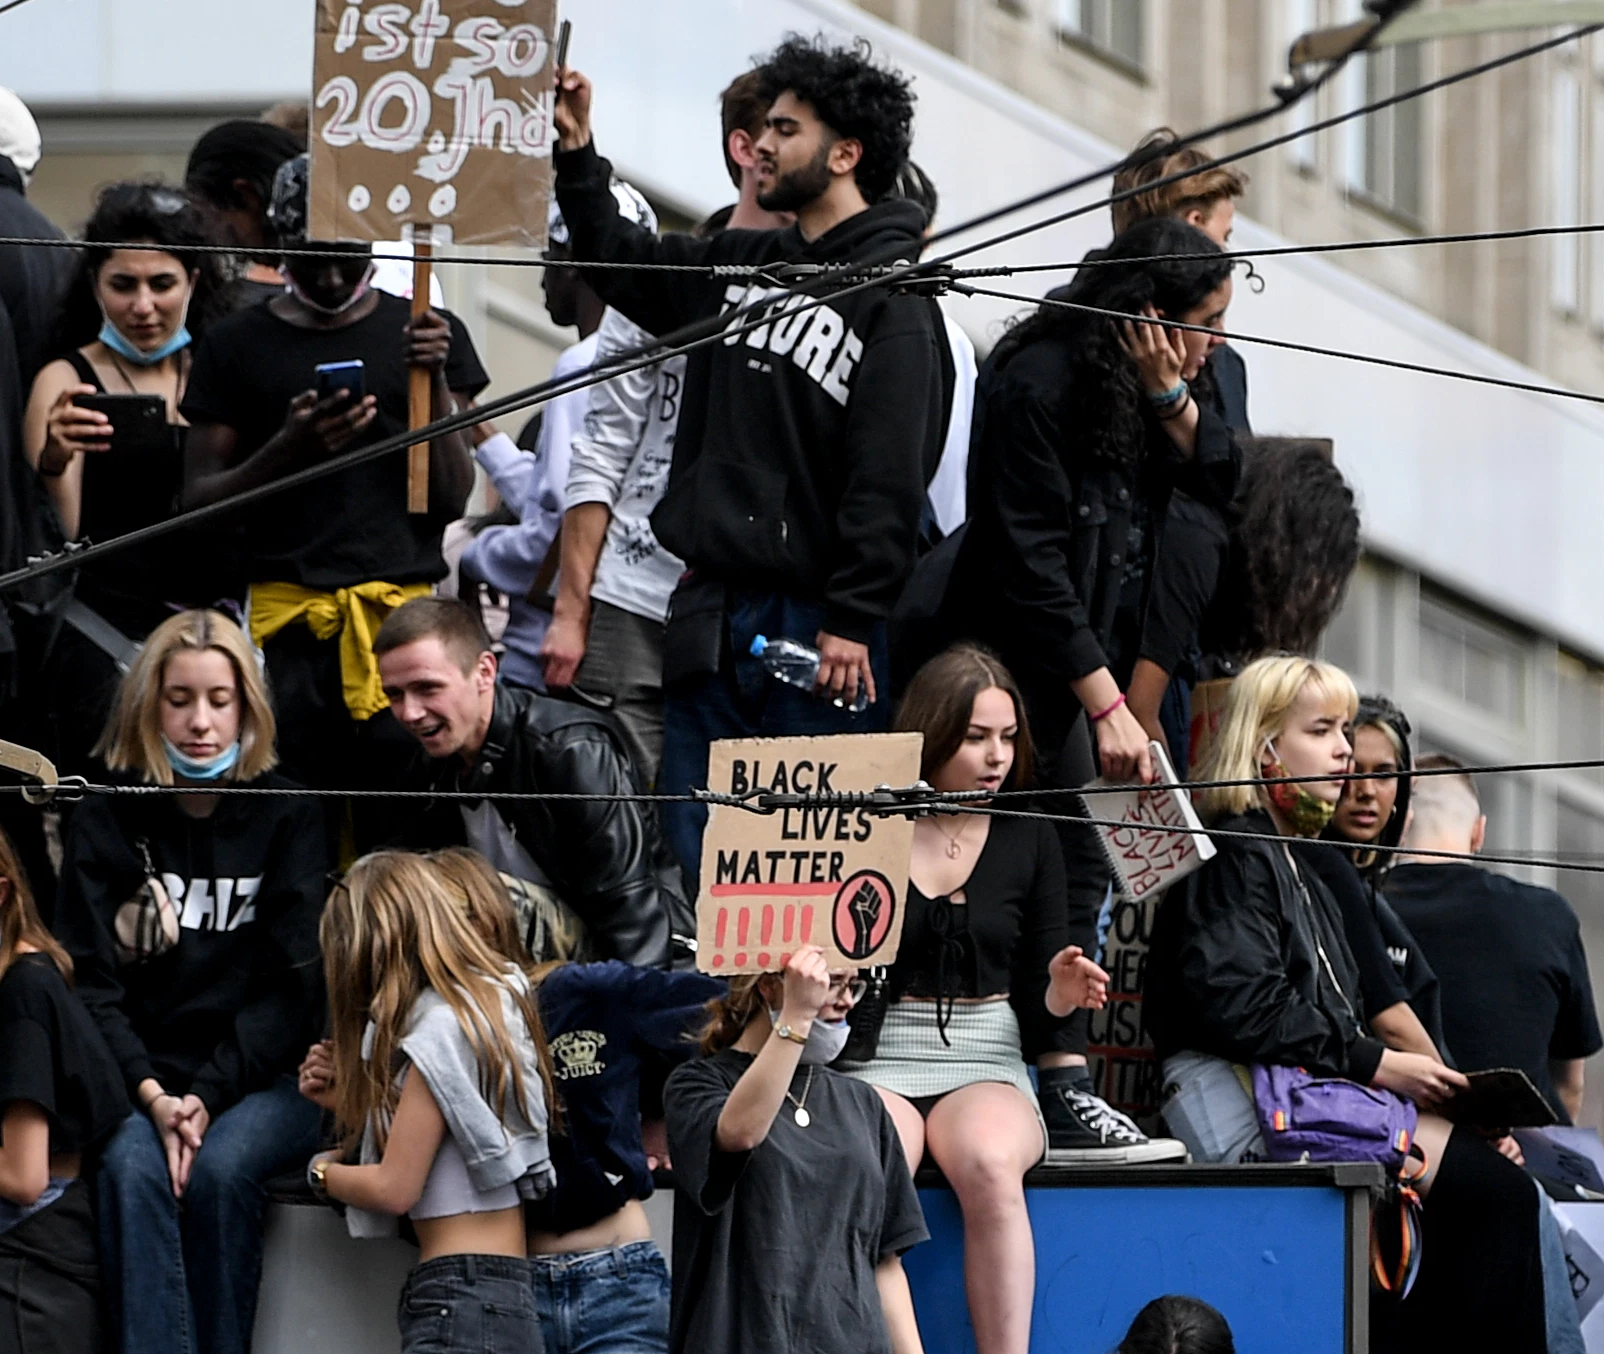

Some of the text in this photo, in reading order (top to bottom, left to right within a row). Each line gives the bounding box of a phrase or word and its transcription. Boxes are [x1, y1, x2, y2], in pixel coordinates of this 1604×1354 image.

[334, 0, 549, 80] ist so
[731, 760, 838, 797] BLACK
[781, 806, 872, 842] LIVES
[716, 850, 844, 884] MATTER
